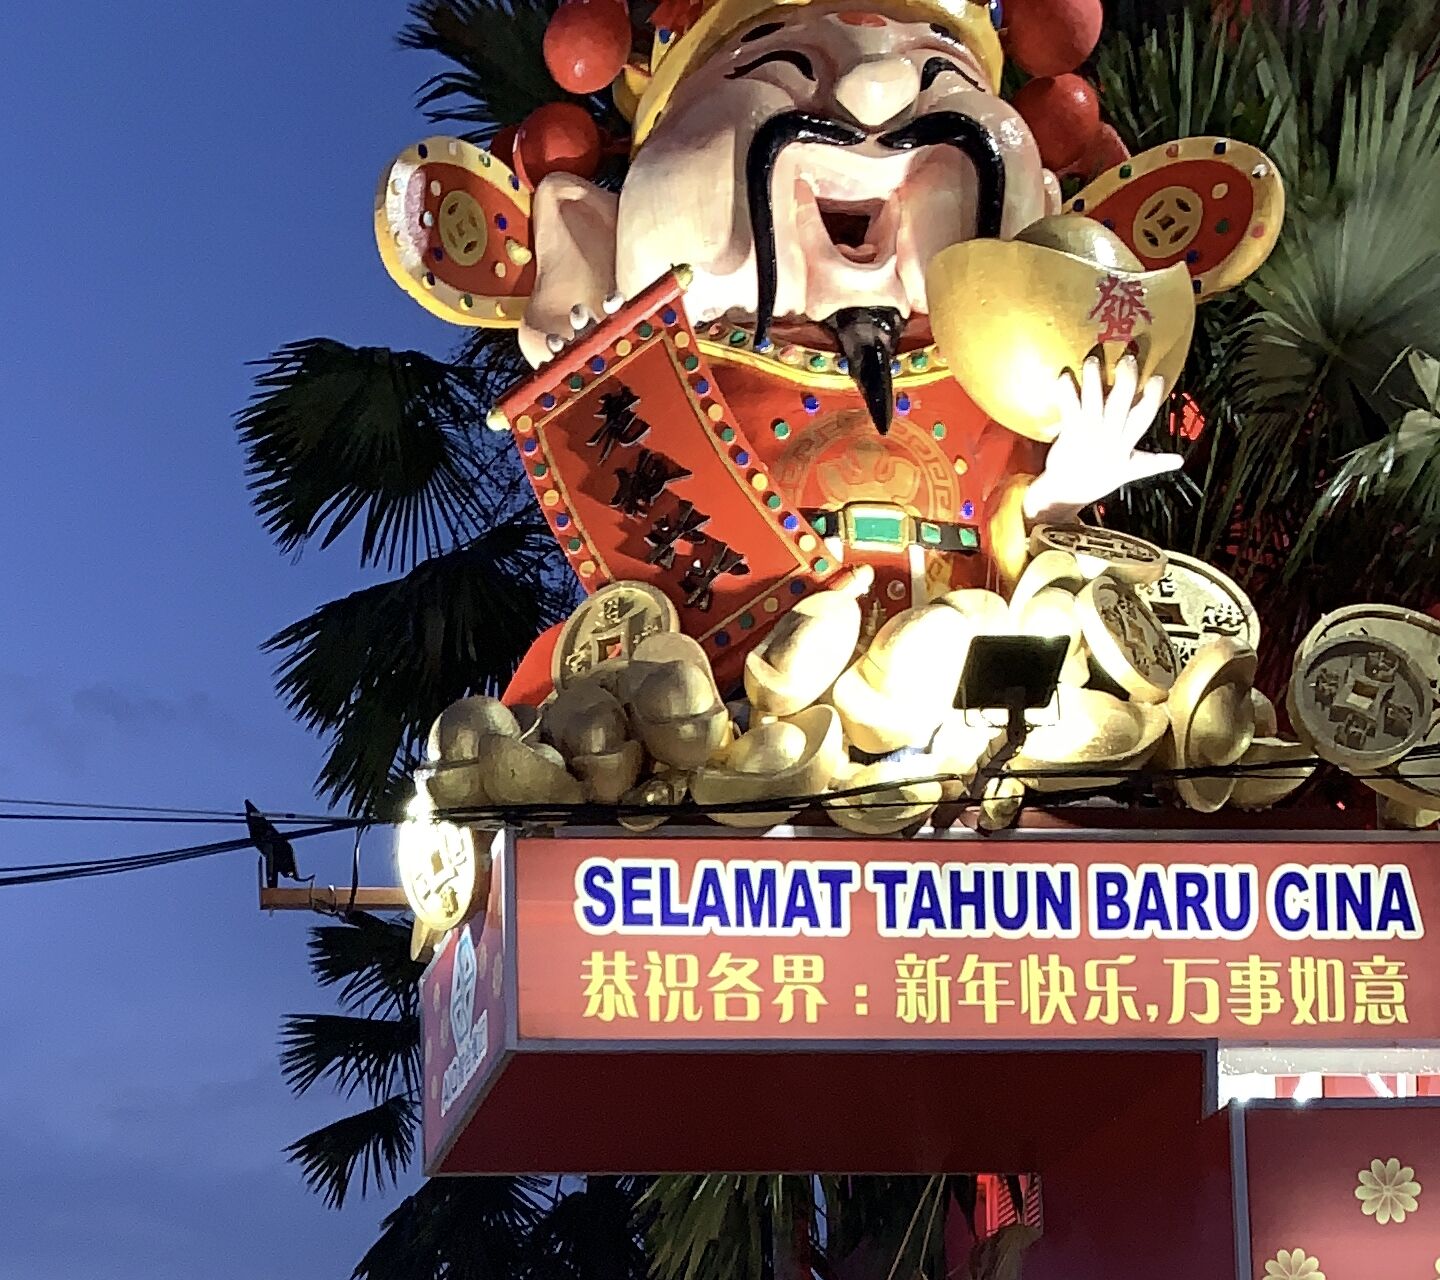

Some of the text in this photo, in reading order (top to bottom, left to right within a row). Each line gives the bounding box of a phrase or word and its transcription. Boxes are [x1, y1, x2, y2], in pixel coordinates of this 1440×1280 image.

[581, 863, 1416, 935] SELAMAT TAHUN BARU CINA
